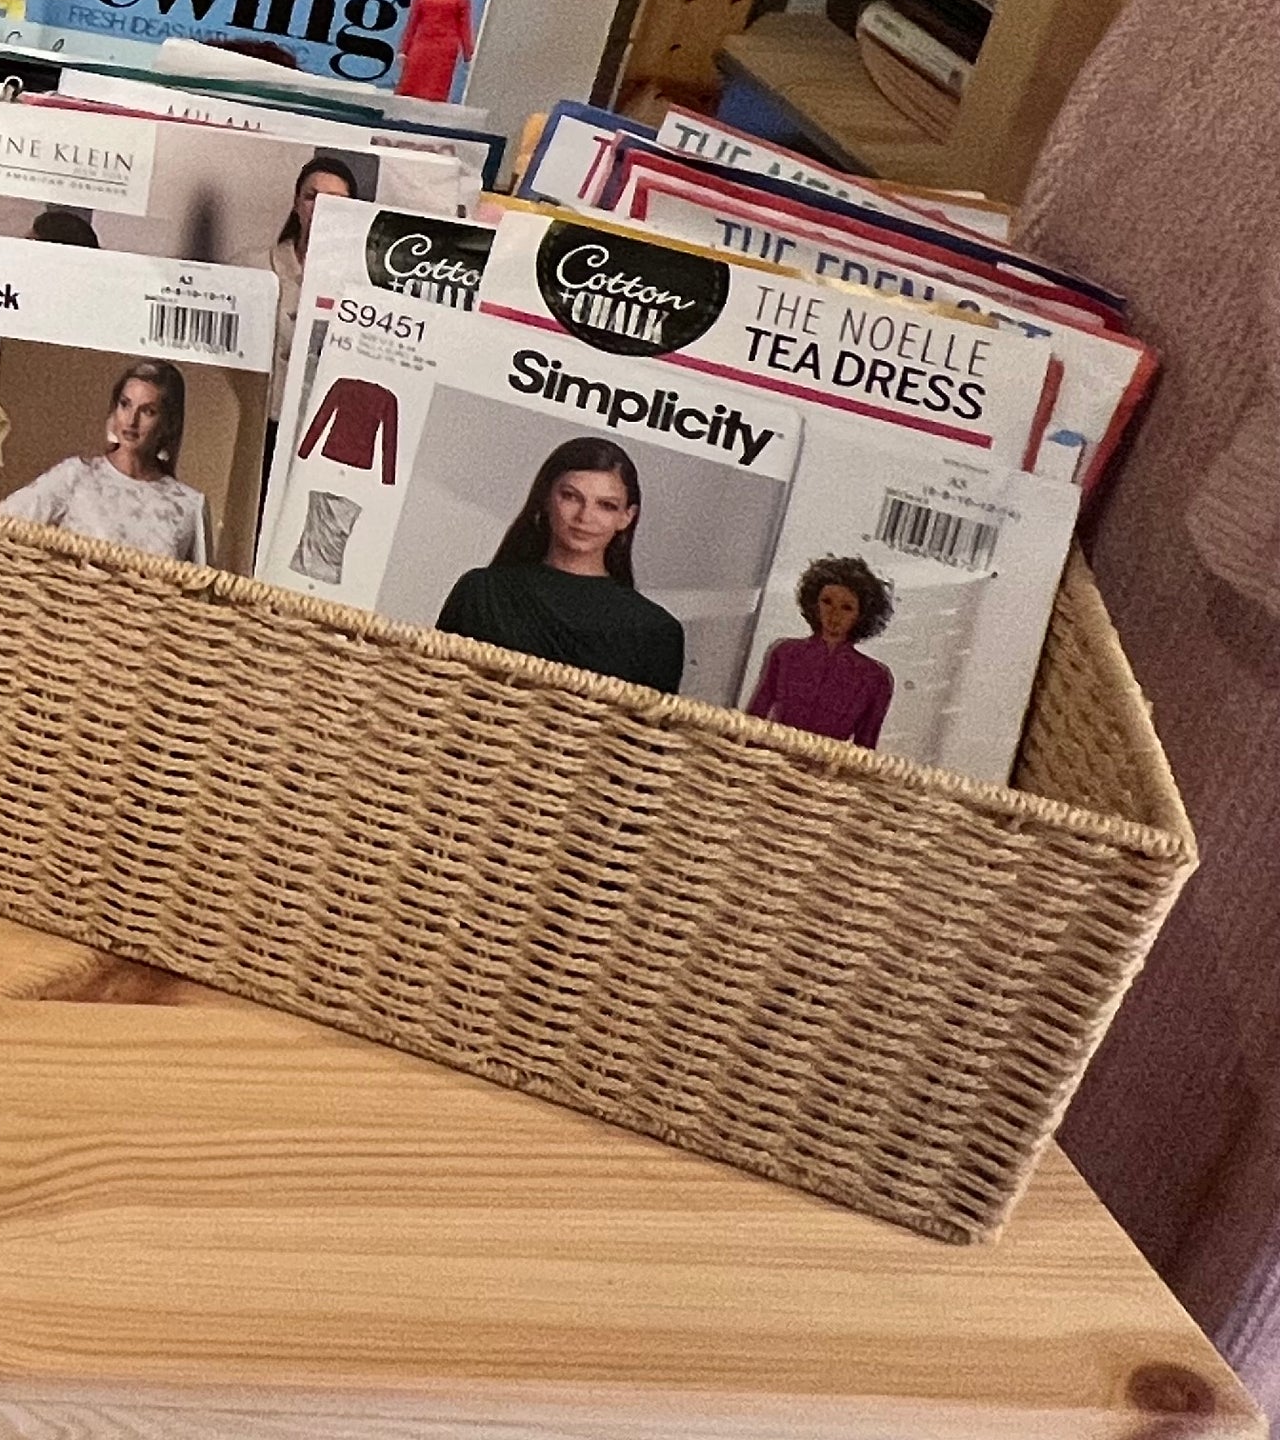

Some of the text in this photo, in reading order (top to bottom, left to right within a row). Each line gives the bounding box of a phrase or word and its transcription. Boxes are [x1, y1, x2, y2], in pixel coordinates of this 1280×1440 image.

[70, 6, 125, 31] FRESH
[131, 17, 183, 39] IDEAS
[54, 143, 134, 171] KLEIN
[556, 244, 696, 311] Cotton
[330, 333, 352, 351] H5
[338, 299, 427, 343] S9451
[756, 285, 825, 336] THE
[839, 307, 992, 378] NOELLE
[745, 326, 986, 420] TEA DRESS
[508, 349, 775, 466] Simplicity
